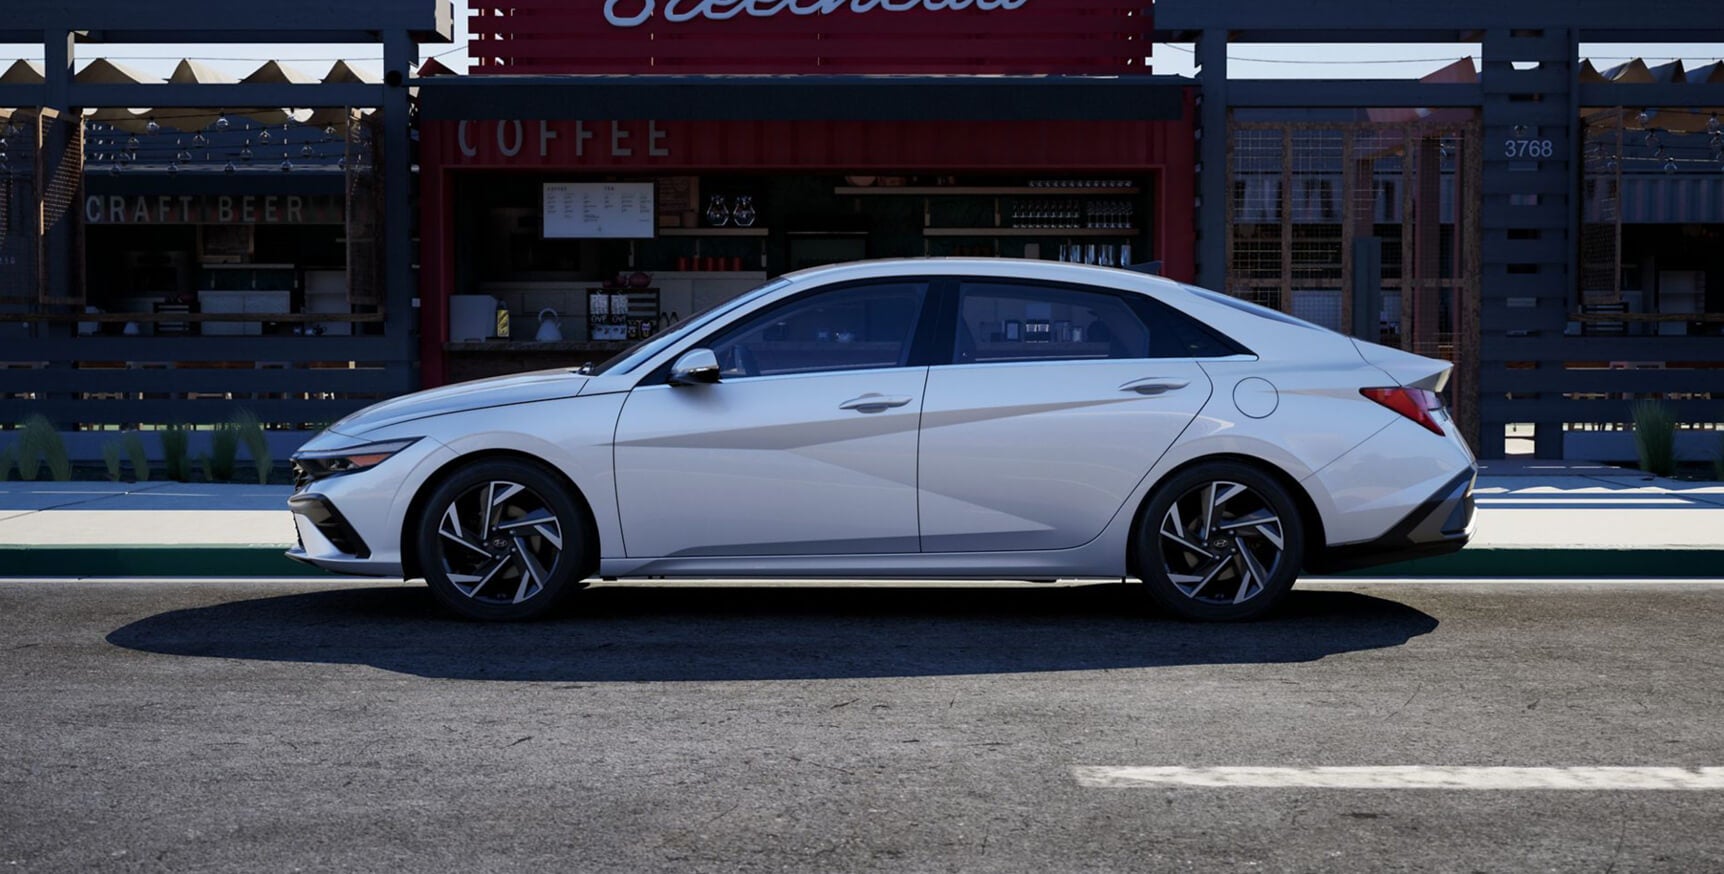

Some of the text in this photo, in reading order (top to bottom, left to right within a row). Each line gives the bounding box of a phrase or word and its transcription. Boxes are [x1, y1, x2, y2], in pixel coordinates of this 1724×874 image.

[457, 120, 669, 156] COFFEE
[1504, 139, 1553, 158] 3768
[86, 195, 304, 223] CRAFT BEER
